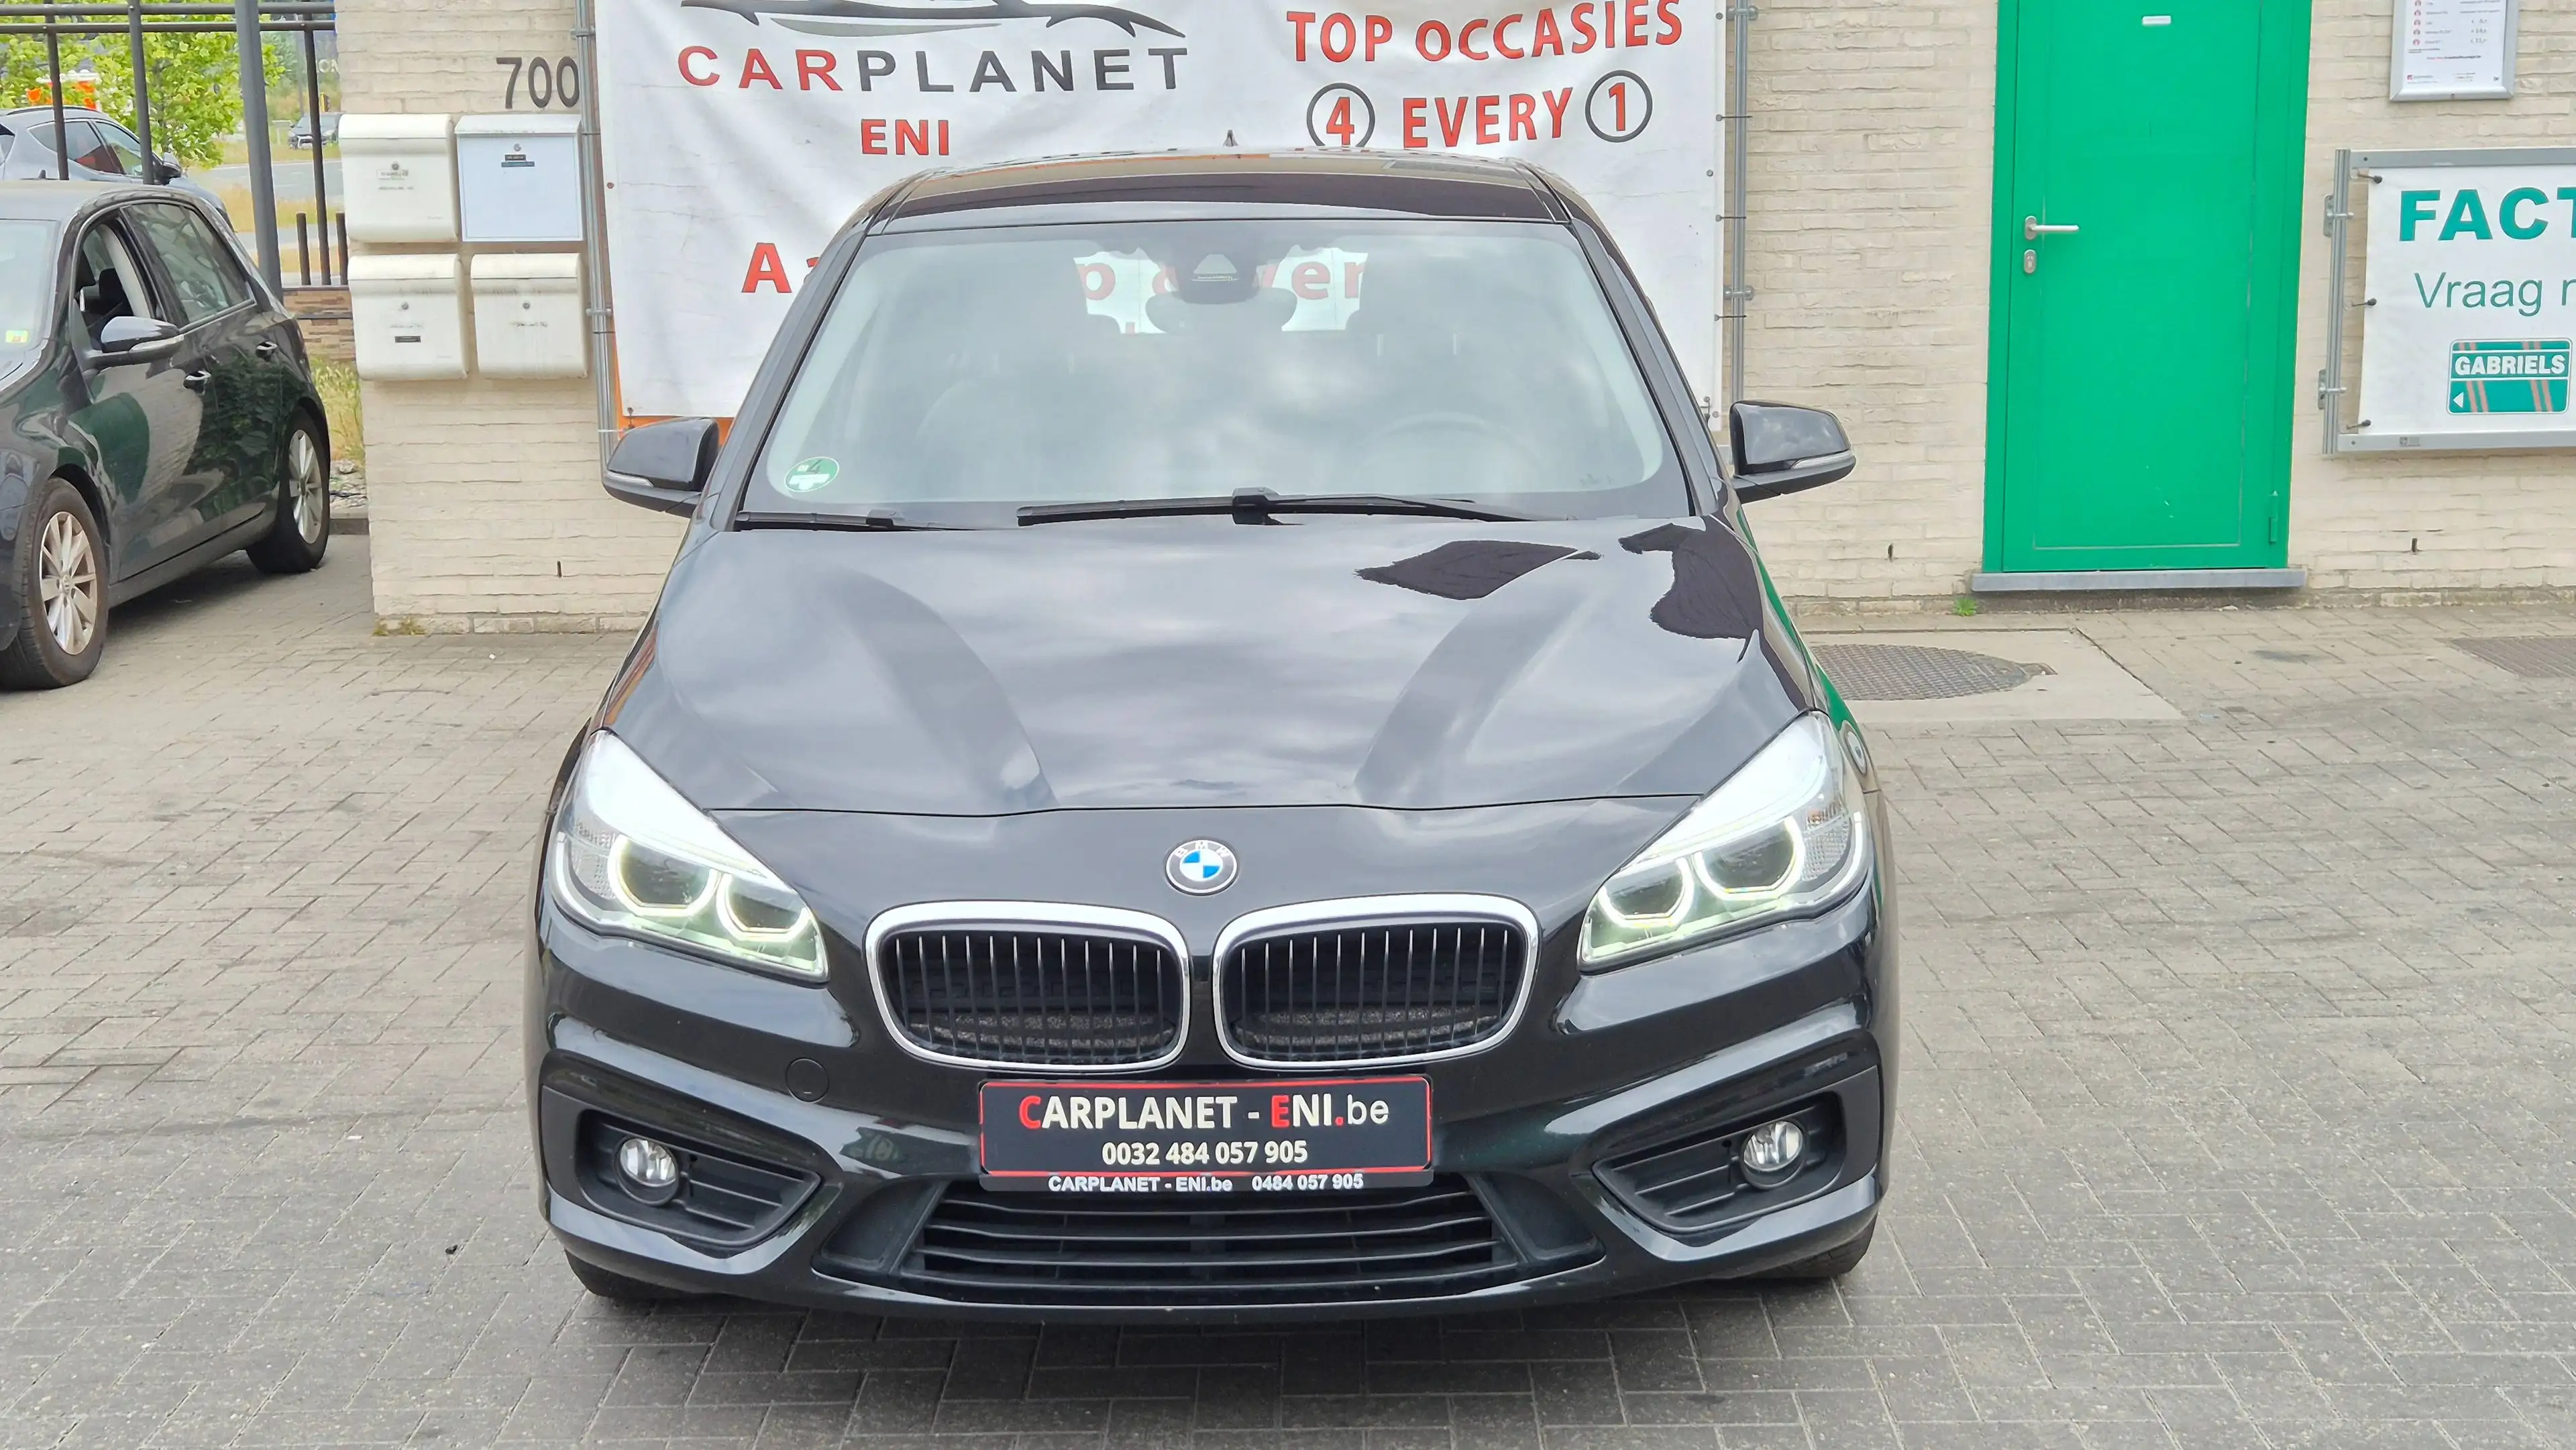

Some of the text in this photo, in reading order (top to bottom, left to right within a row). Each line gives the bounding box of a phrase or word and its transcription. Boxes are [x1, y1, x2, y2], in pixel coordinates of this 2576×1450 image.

[1287, 0, 1682, 63] TOP OCCASIES
[496, 56, 580, 109] 700
[678, 45, 1188, 93] CARPLANET
[1326, 83, 1626, 148] 4 EVERY 1
[861, 119, 949, 156] ENI
[2414, 272, 2542, 317] Vraag
[2455, 354, 2566, 376] GABRIELS
[1018, 1095, 1238, 1130] CARPLANET
[1271, 1093, 1390, 1129] ENI.be
[1102, 1140, 1308, 1166] 0032 484 057 905
[1048, 1176, 1161, 1192] CARPLANET
[1175, 1176, 1233, 1192] ENI.be
[1252, 1175, 1294, 1191] 0484
[1297, 1174, 1328, 1190] 057
[1332, 1173, 1364, 1190] 905
